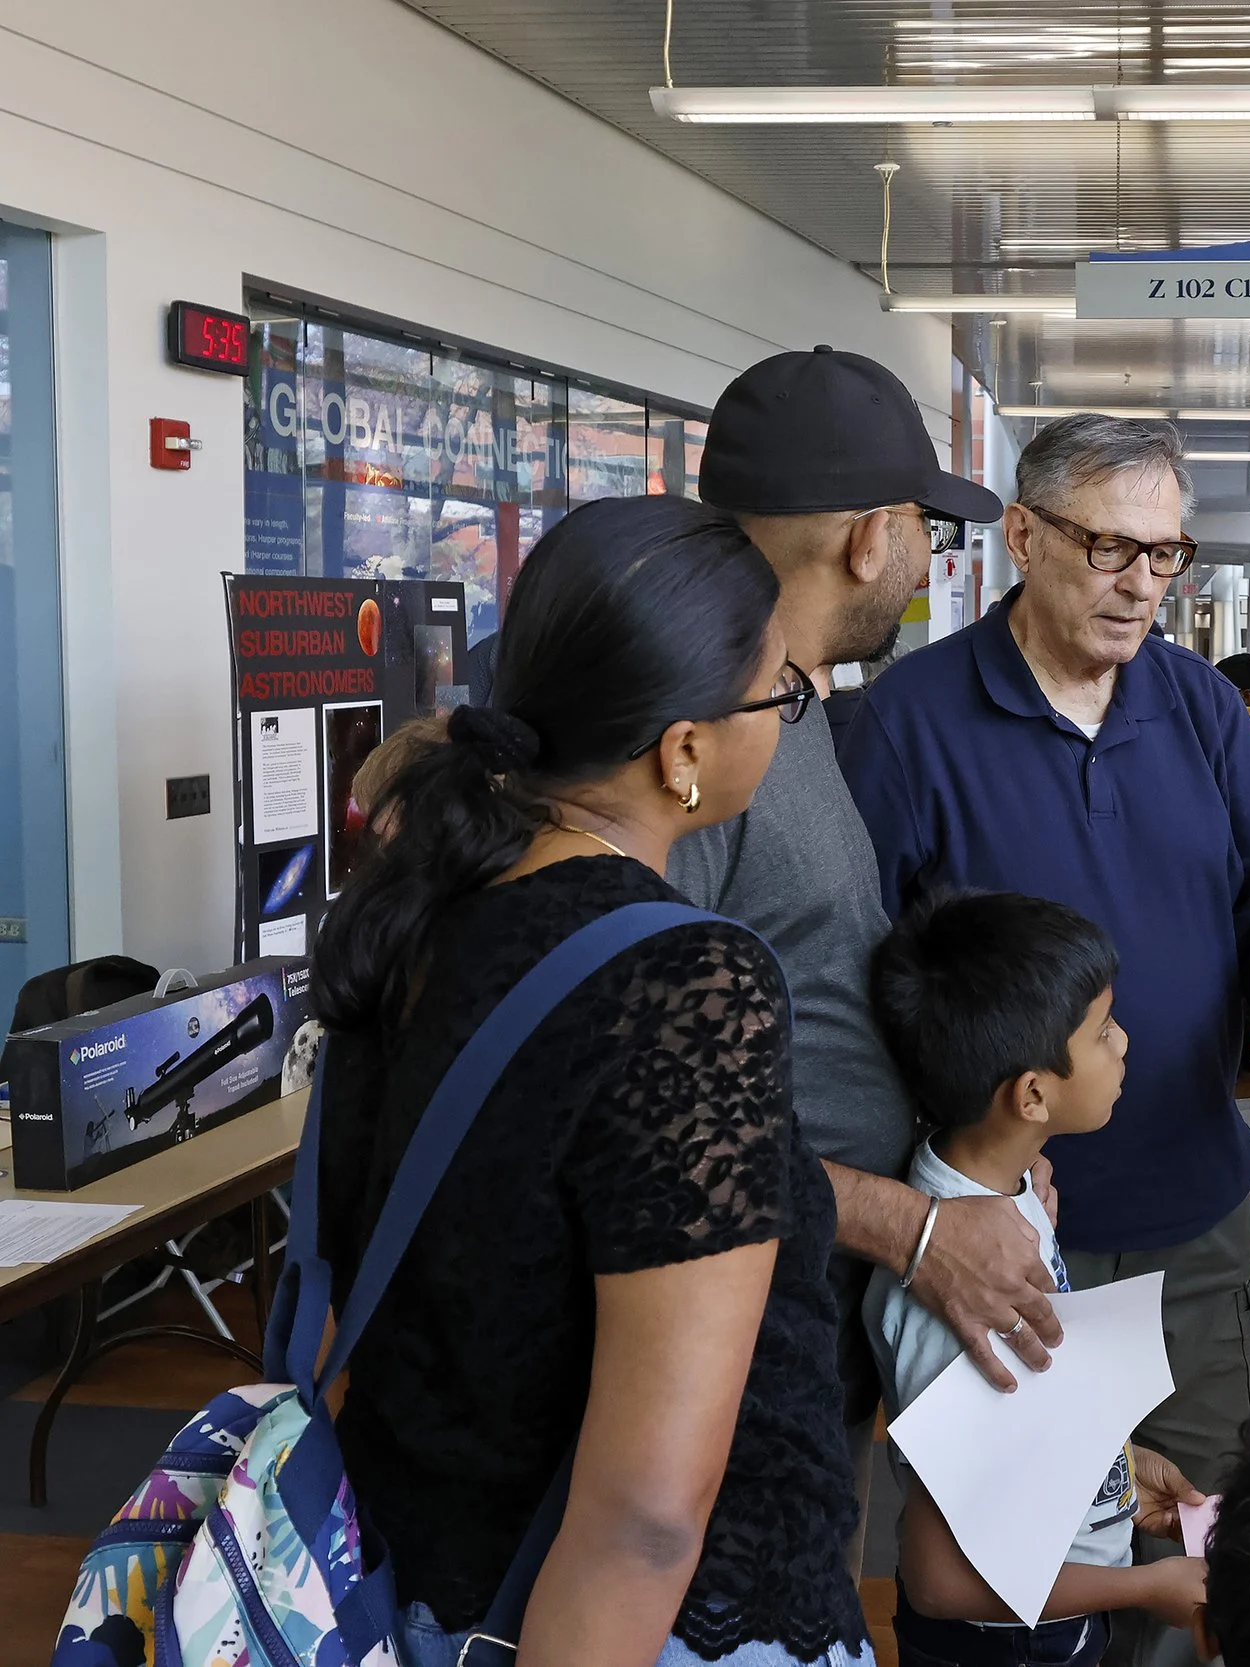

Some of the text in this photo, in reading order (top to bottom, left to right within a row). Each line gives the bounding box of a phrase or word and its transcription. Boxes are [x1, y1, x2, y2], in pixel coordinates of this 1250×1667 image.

[1149, 278, 1165, 299] Z
[1177, 278, 1215, 299] 102
[202, 316, 243, 362] 5:35
[239, 590, 354, 618] NORTHWEST
[240, 629, 345, 657] SUBURBAN
[239, 668, 375, 699] ASTRONOMERS
[81, 1033, 126, 1062] Polaroid
[25, 1112, 53, 1121] Polaroid
